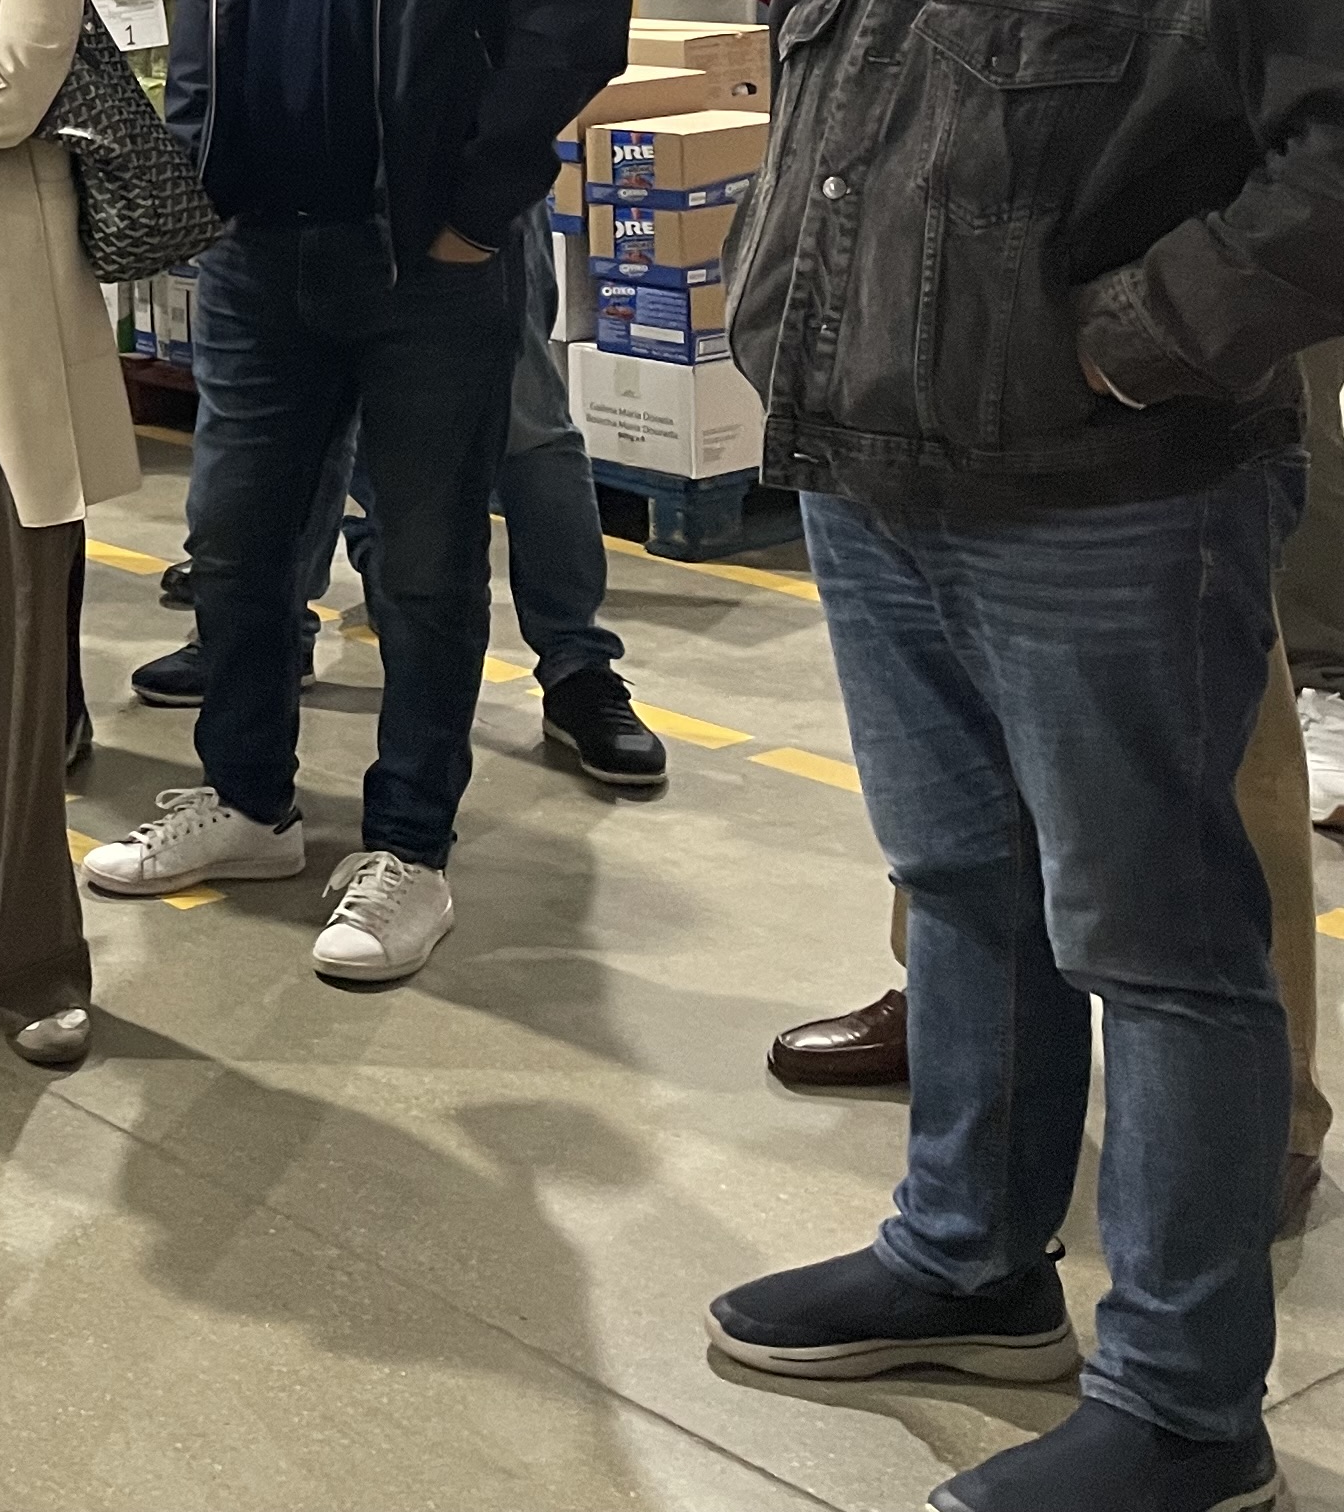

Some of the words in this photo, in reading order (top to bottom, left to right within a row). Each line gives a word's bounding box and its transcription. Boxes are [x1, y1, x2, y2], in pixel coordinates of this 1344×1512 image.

[124, 24, 137, 46] 1
[613, 145, 655, 164] RE
[614, 220, 655, 239] RE
